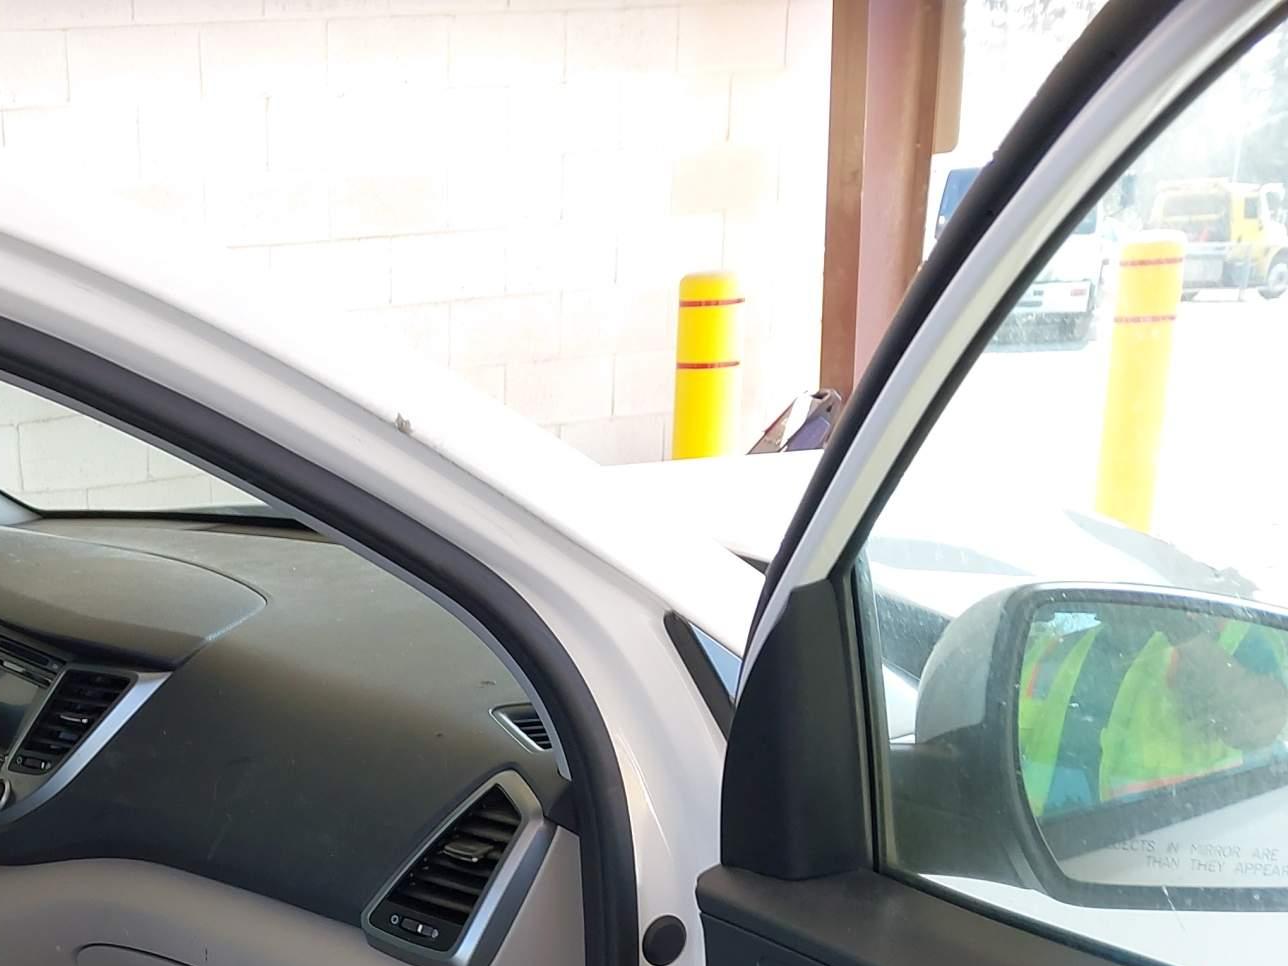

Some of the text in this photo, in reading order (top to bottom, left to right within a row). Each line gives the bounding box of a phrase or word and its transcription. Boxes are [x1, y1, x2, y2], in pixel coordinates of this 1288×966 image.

[1190, 843, 1241, 858] MIRROR
[1251, 847, 1281, 862] ARE
[1146, 855, 1180, 870] THAN
[1190, 857, 1225, 873] THEY
